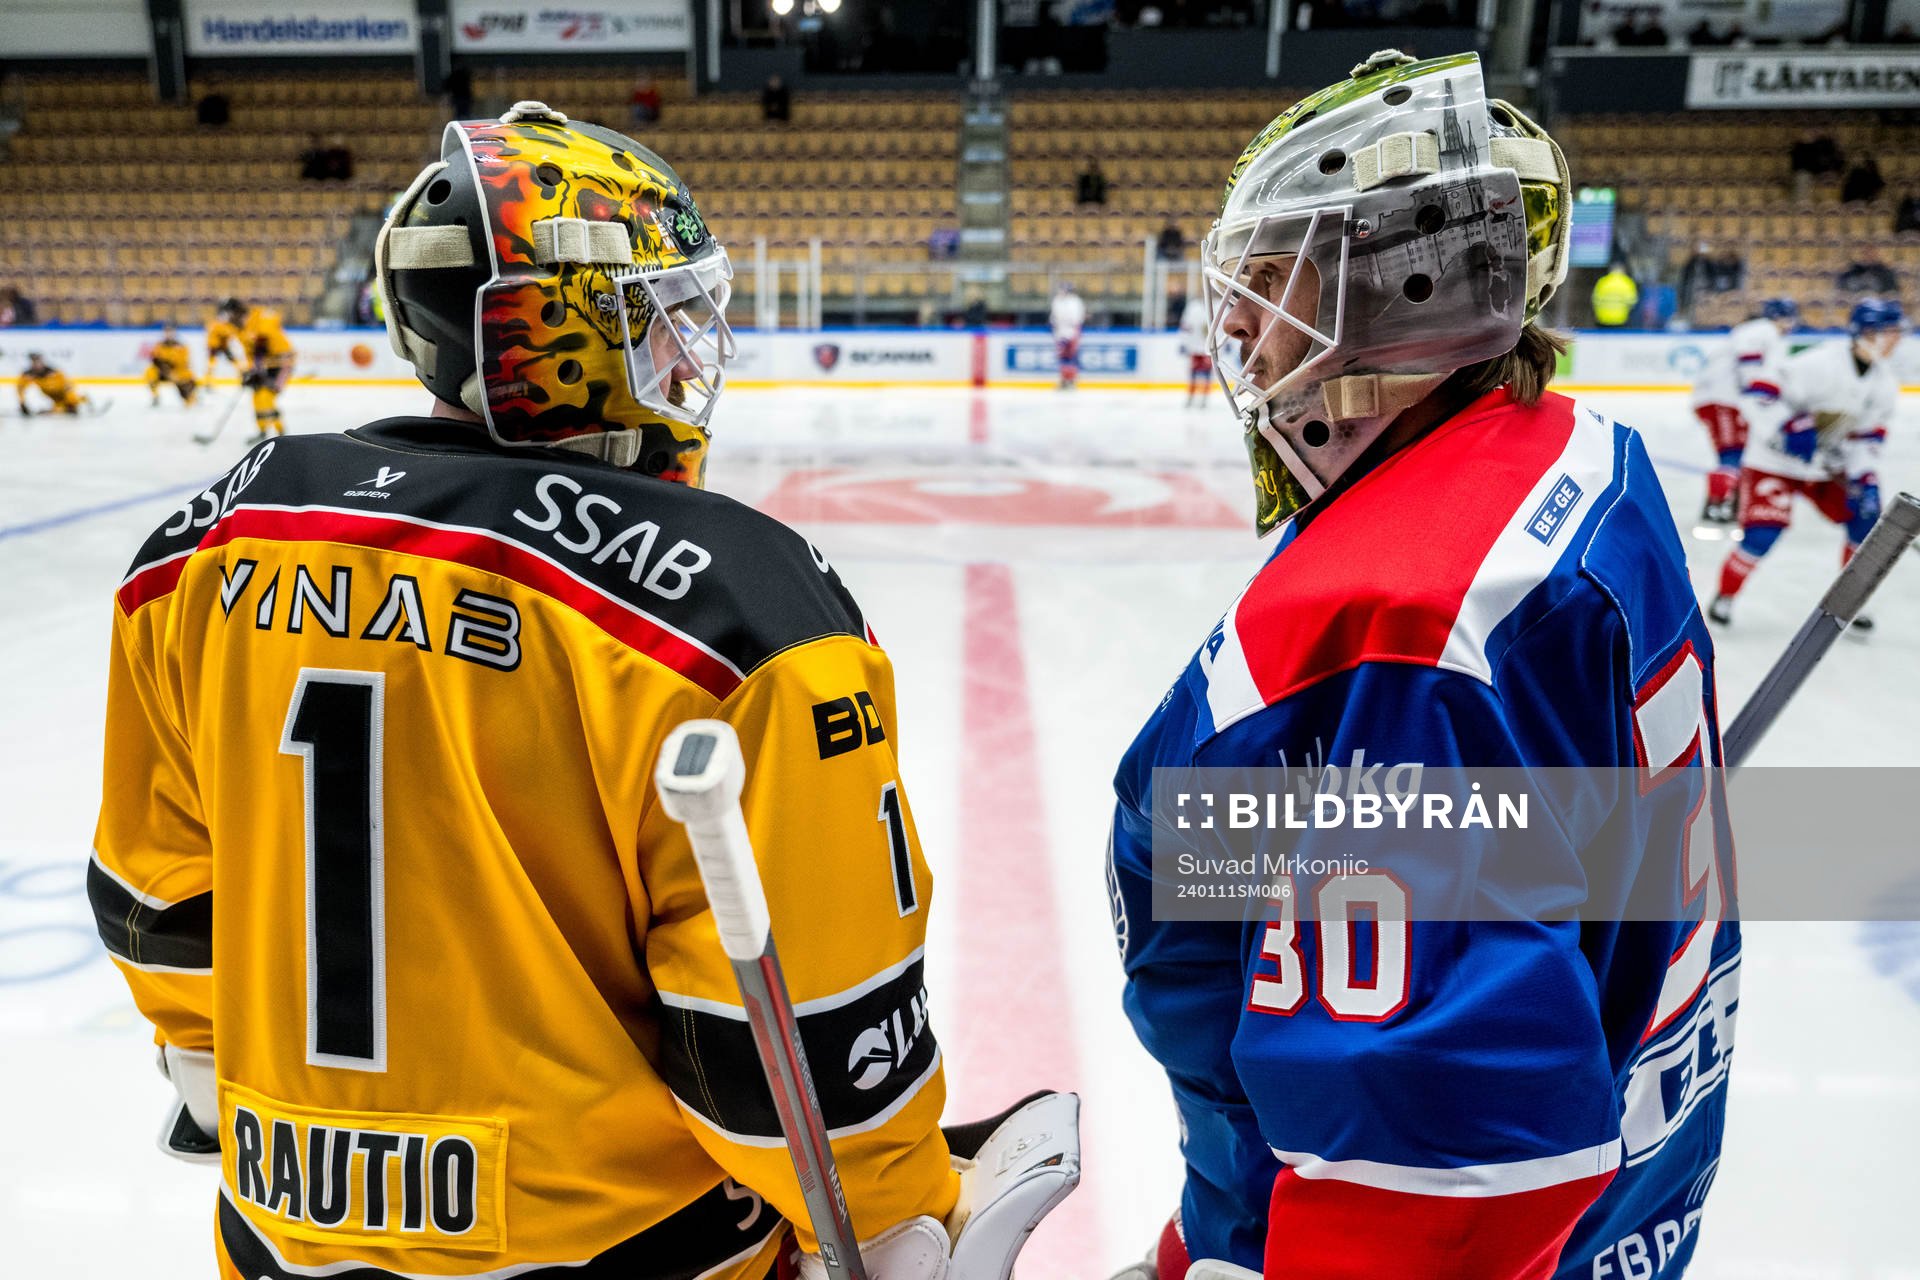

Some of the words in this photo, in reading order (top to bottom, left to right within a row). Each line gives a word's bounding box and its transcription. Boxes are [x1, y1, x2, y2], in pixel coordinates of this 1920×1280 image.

[203, 15, 409, 41] Handelsbanken
[513, 474, 712, 600] SSAB
[218, 558, 523, 672] VINAB
[279, 667, 388, 1073] 1
[877, 780, 919, 918] 1
[1247, 868, 1412, 1022] 30
[234, 1104, 477, 1235] RAUTIO
